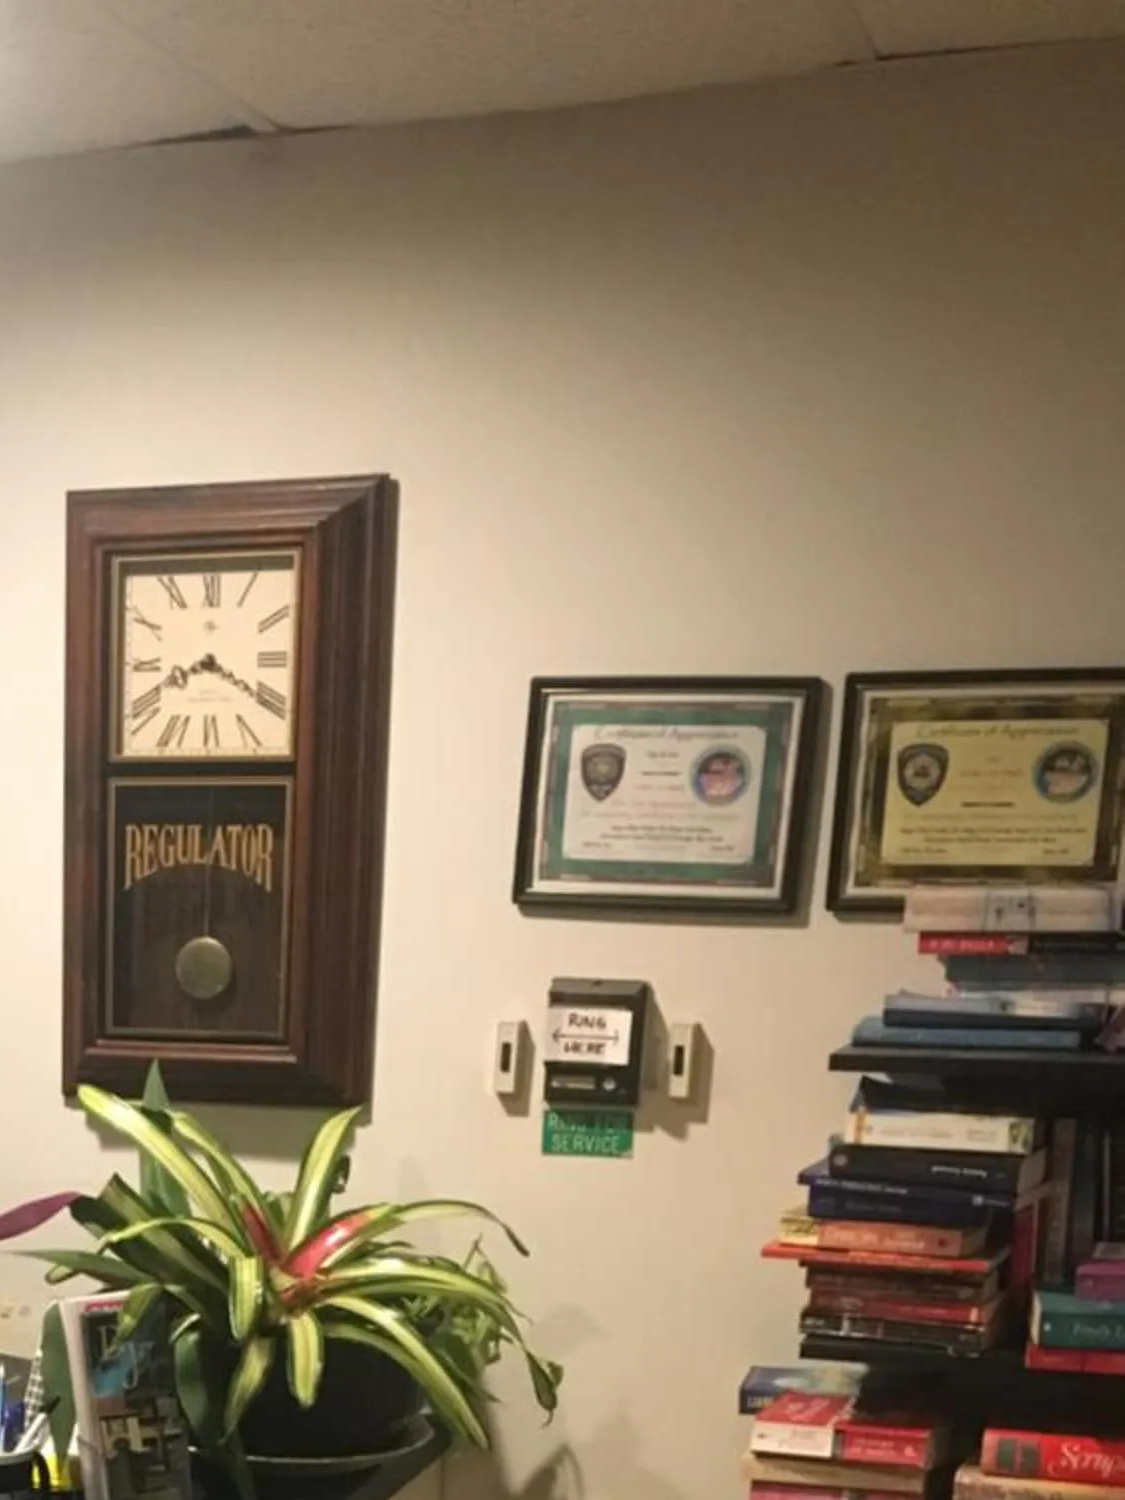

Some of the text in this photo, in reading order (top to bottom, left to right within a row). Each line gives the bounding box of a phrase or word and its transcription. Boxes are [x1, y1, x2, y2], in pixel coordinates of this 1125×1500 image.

[124, 823, 274, 893] REGULATOR
[568, 1012, 607, 1030] RING
[562, 1041, 606, 1056] HERE
[550, 1134, 621, 1153] SERVICE
